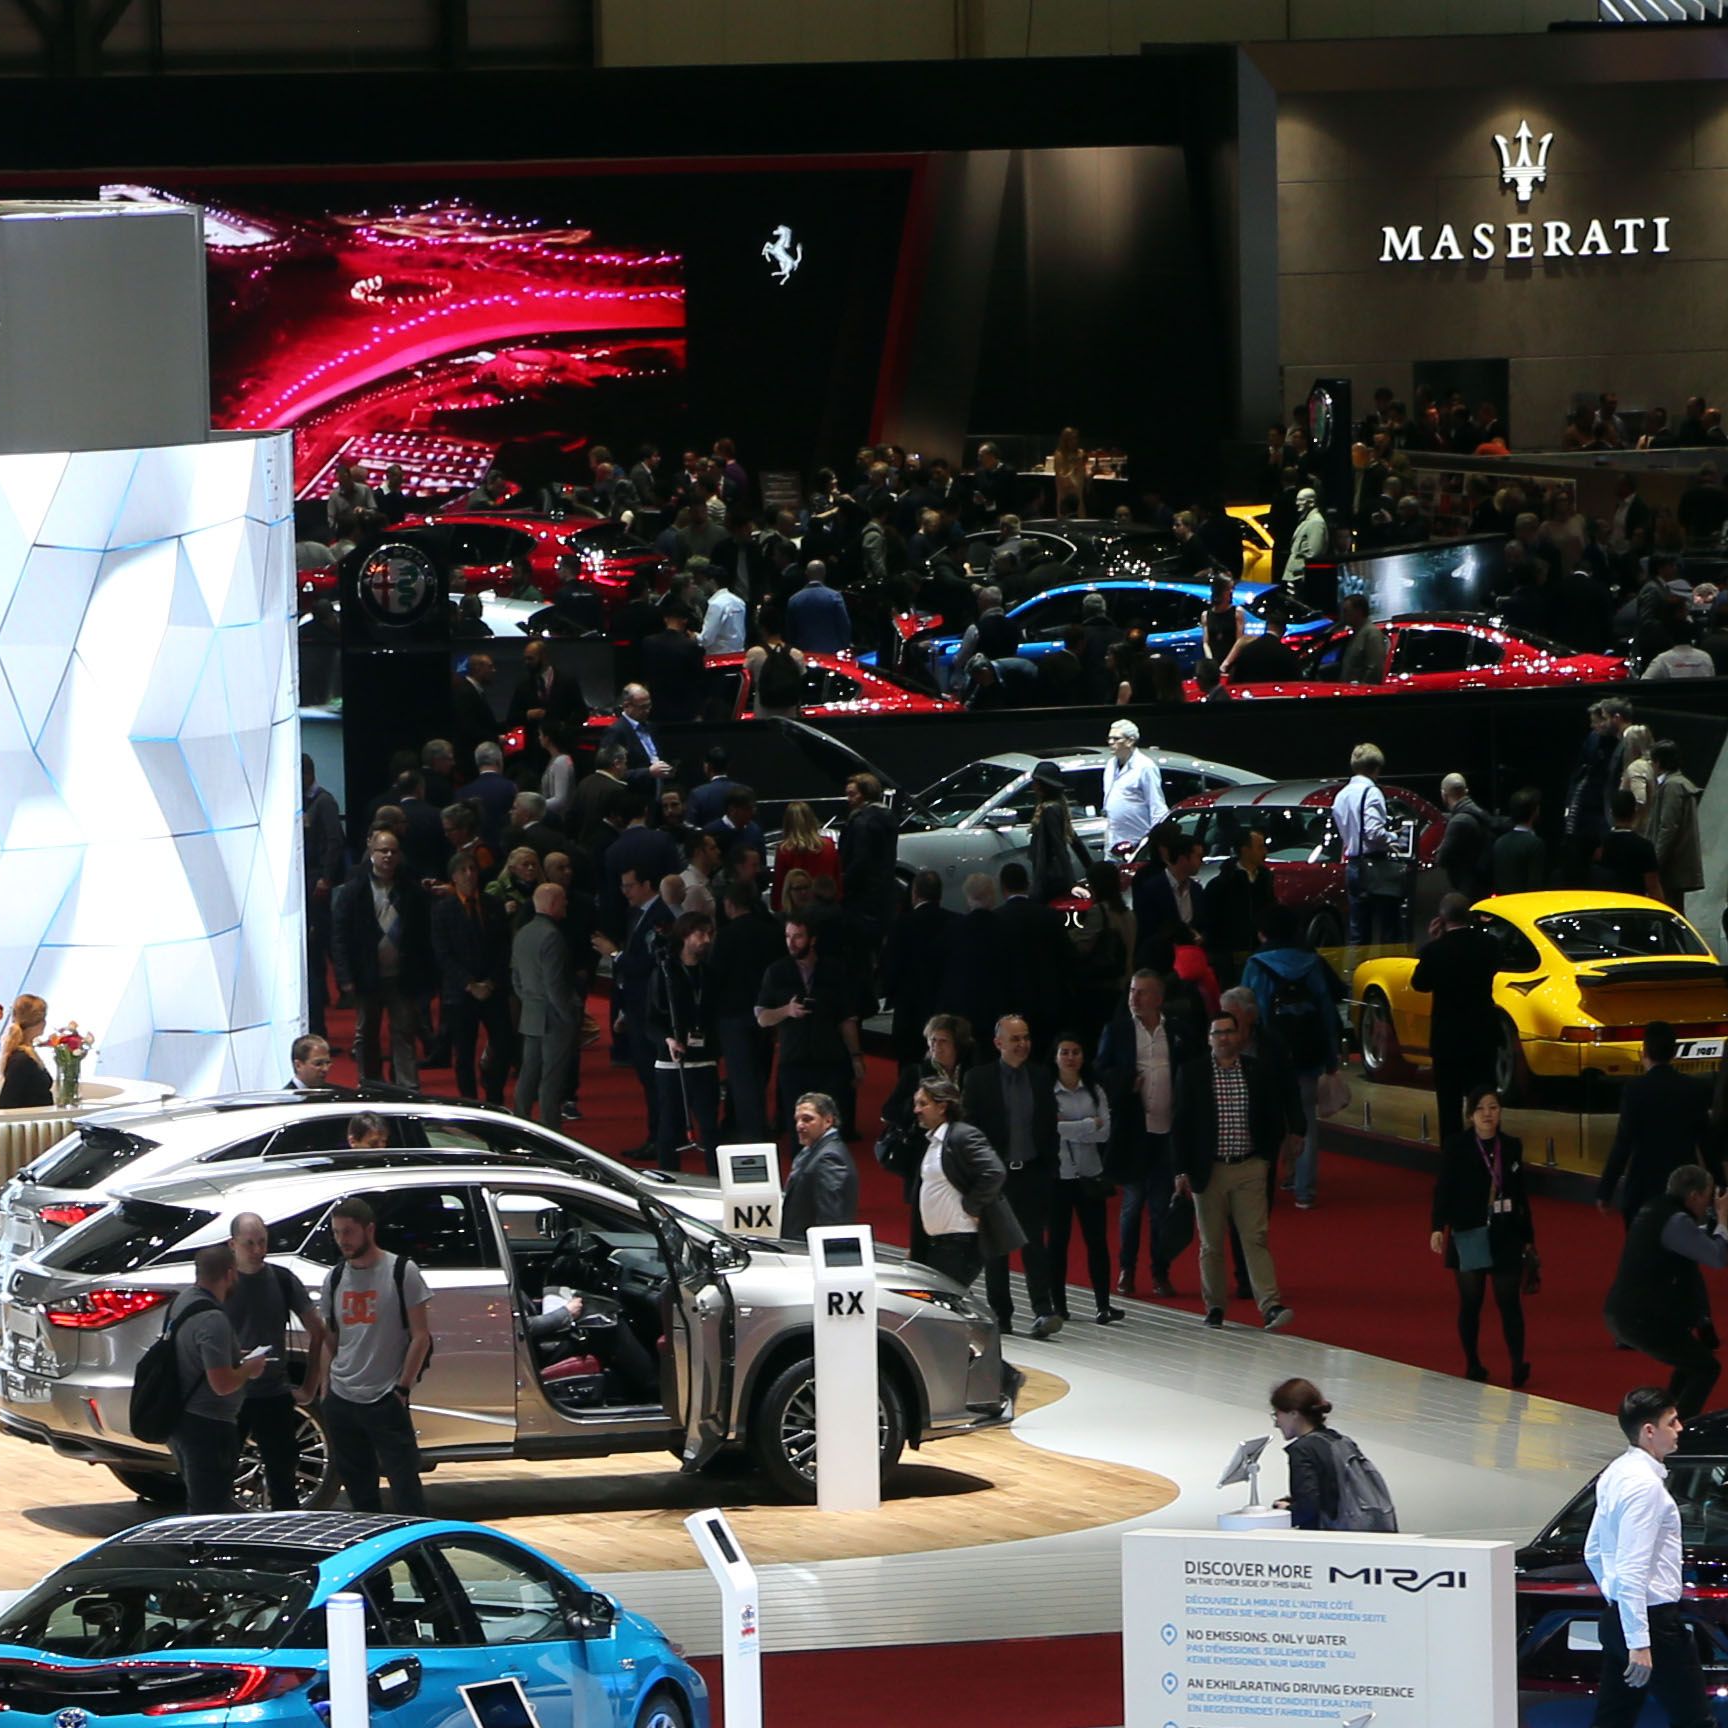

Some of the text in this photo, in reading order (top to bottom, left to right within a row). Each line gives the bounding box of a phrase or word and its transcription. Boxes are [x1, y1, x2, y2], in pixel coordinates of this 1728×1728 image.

[1379, 216, 1672, 263] MASERATI
[733, 1205, 773, 1229] NX
[827, 1290, 865, 1316] RX
[1185, 1561, 1313, 1579] DISCOVER MORE
[1185, 1577, 1197, 1585] ON
[1215, 1578, 1240, 1586] OTHER
[1290, 1582, 1312, 1590] WALL
[1329, 1566, 1466, 1593] MIRAI
[1185, 1595, 1239, 1606] DÉCOUVREZ
[1241, 1597, 1252, 1606] LA
[1253, 1597, 1277, 1607] MIRAI
[1279, 1598, 1290, 1607] DE
[1293, 1599, 1328, 1608] L'AUTRE
[1185, 1607, 1387, 1623] ENTDECKEN SIE MEHR AUF DER ANDEREN SEITE
[1186, 1630, 1347, 1646] NO EMISSIONS. ONLY WATER
[1186, 1644, 1204, 1652] PAS
[1264, 1647, 1316, 1657] SEULEMENT
[1317, 1649, 1328, 1657] DE
[1330, 1650, 1356, 1659] L'EAU
[1187, 1656, 1212, 1664] KEINE
[1270, 1659, 1288, 1667] NUR
[1290, 1660, 1326, 1669] WASSER
[1187, 1678, 1415, 1698] AN EXHILARATING DRIVING EXPERIENCE
[1187, 1693, 1373, 1709] UNE EXPÉRIENCE DE CONDUITE EXALTANTE
[1187, 1705, 1340, 1719] EIN BEGEISTERNDES FAHRERLEBNIS
